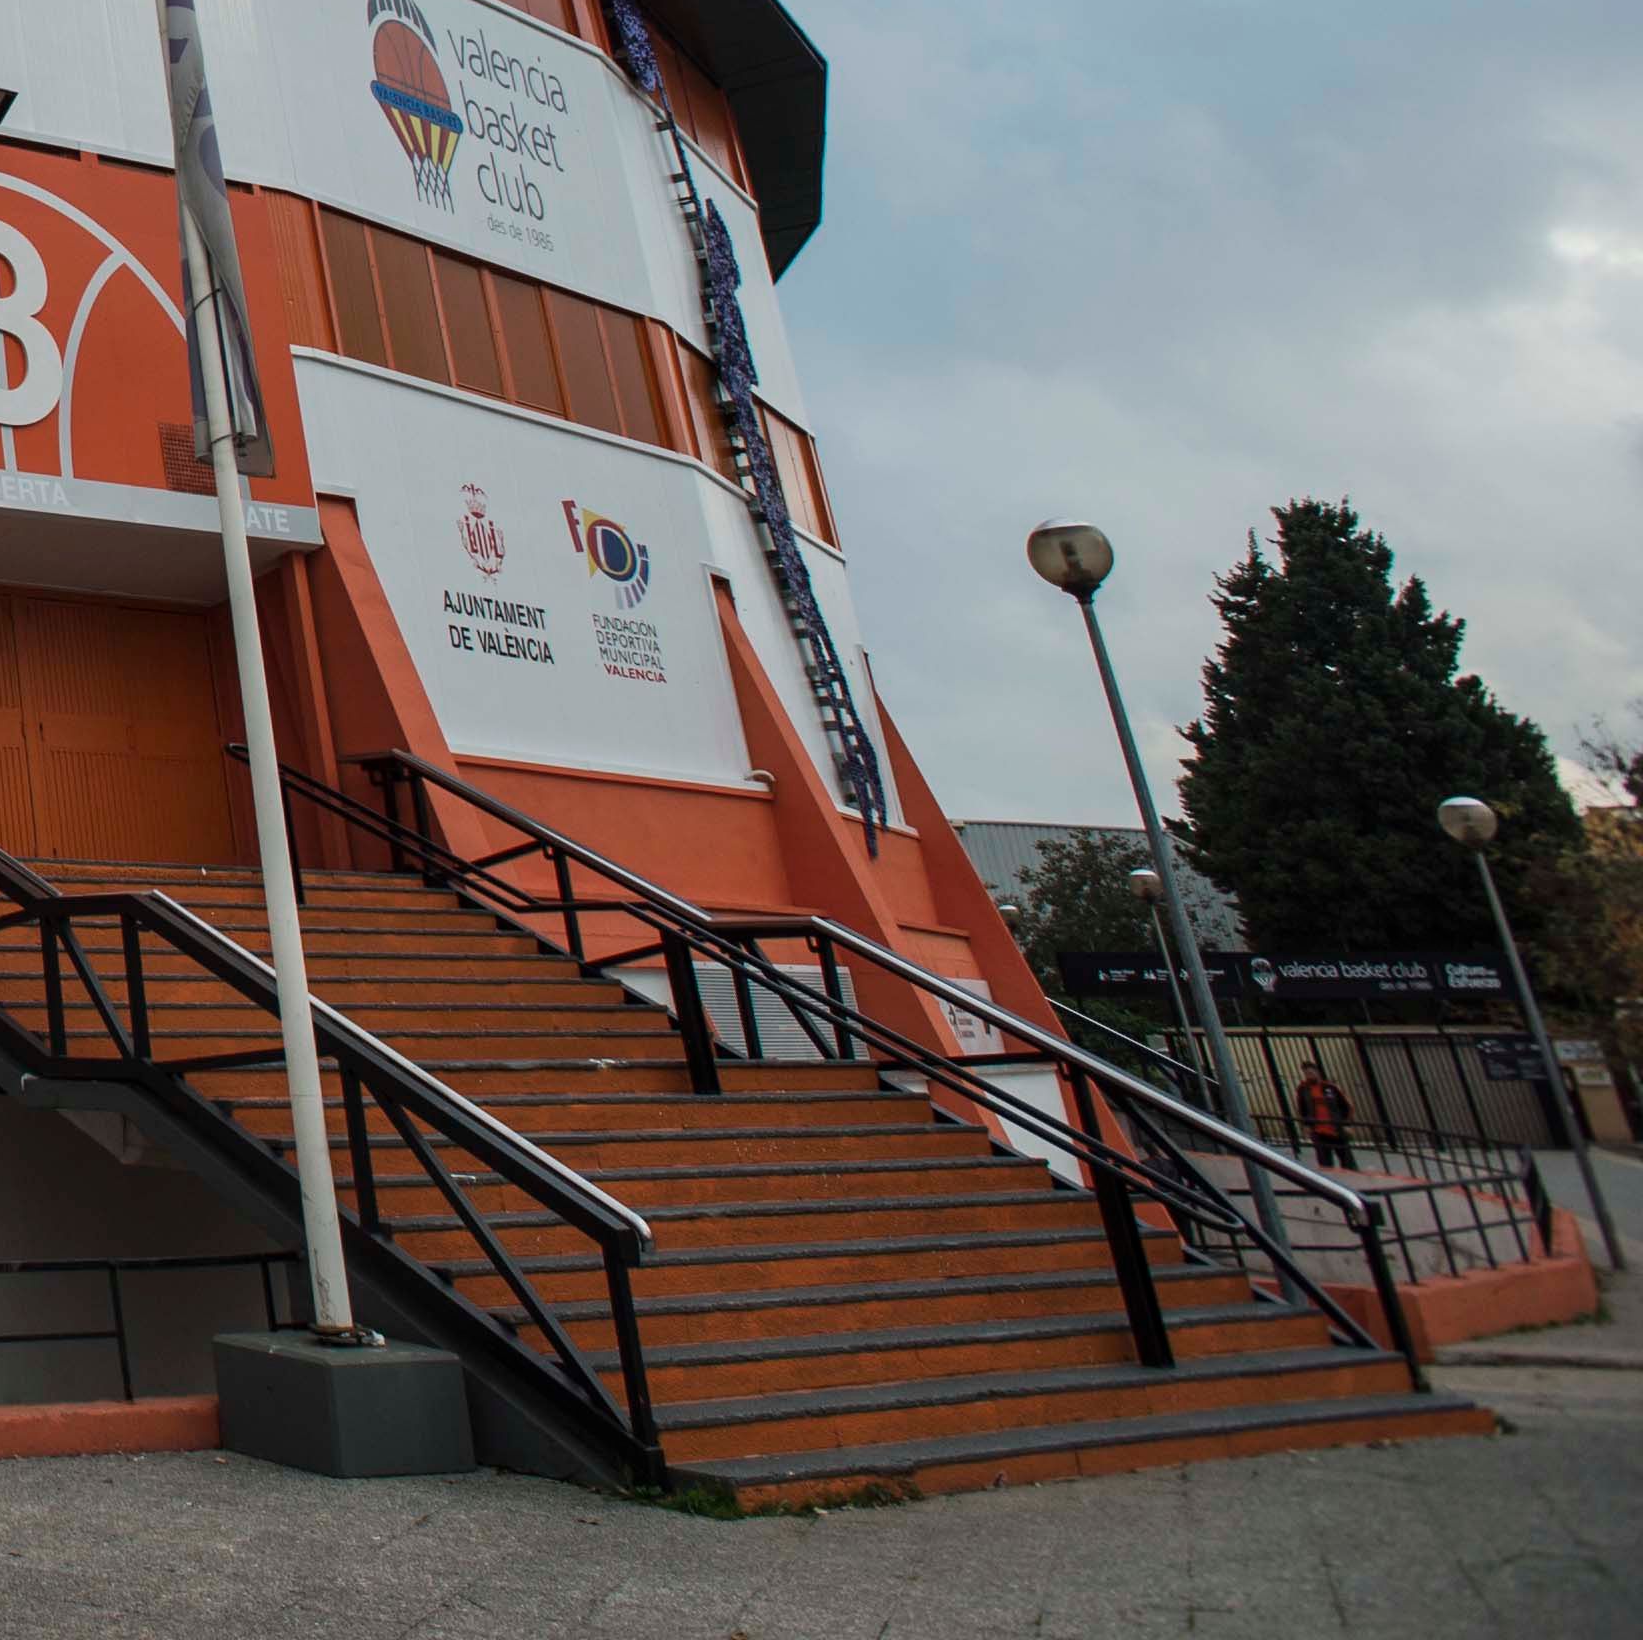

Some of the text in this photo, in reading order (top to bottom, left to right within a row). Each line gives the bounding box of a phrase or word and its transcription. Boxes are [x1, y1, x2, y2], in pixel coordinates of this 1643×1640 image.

[447, 28, 568, 114] valencia
[459, 80, 564, 172] basket
[477, 152, 544, 221] club
[245, 504, 291, 533] ATE
[443, 589, 547, 630] AJUNTAMENT
[592, 613, 658, 639] FUNDACIÓN
[448, 624, 555, 665] DE VALÈNCIA
[596, 630, 661, 653] DEPORTIVA
[600, 646, 665, 670] MUNICIPAL
[604, 662, 667, 683] VALENCIA
[1278, 961, 1427, 978] valencia basket club
